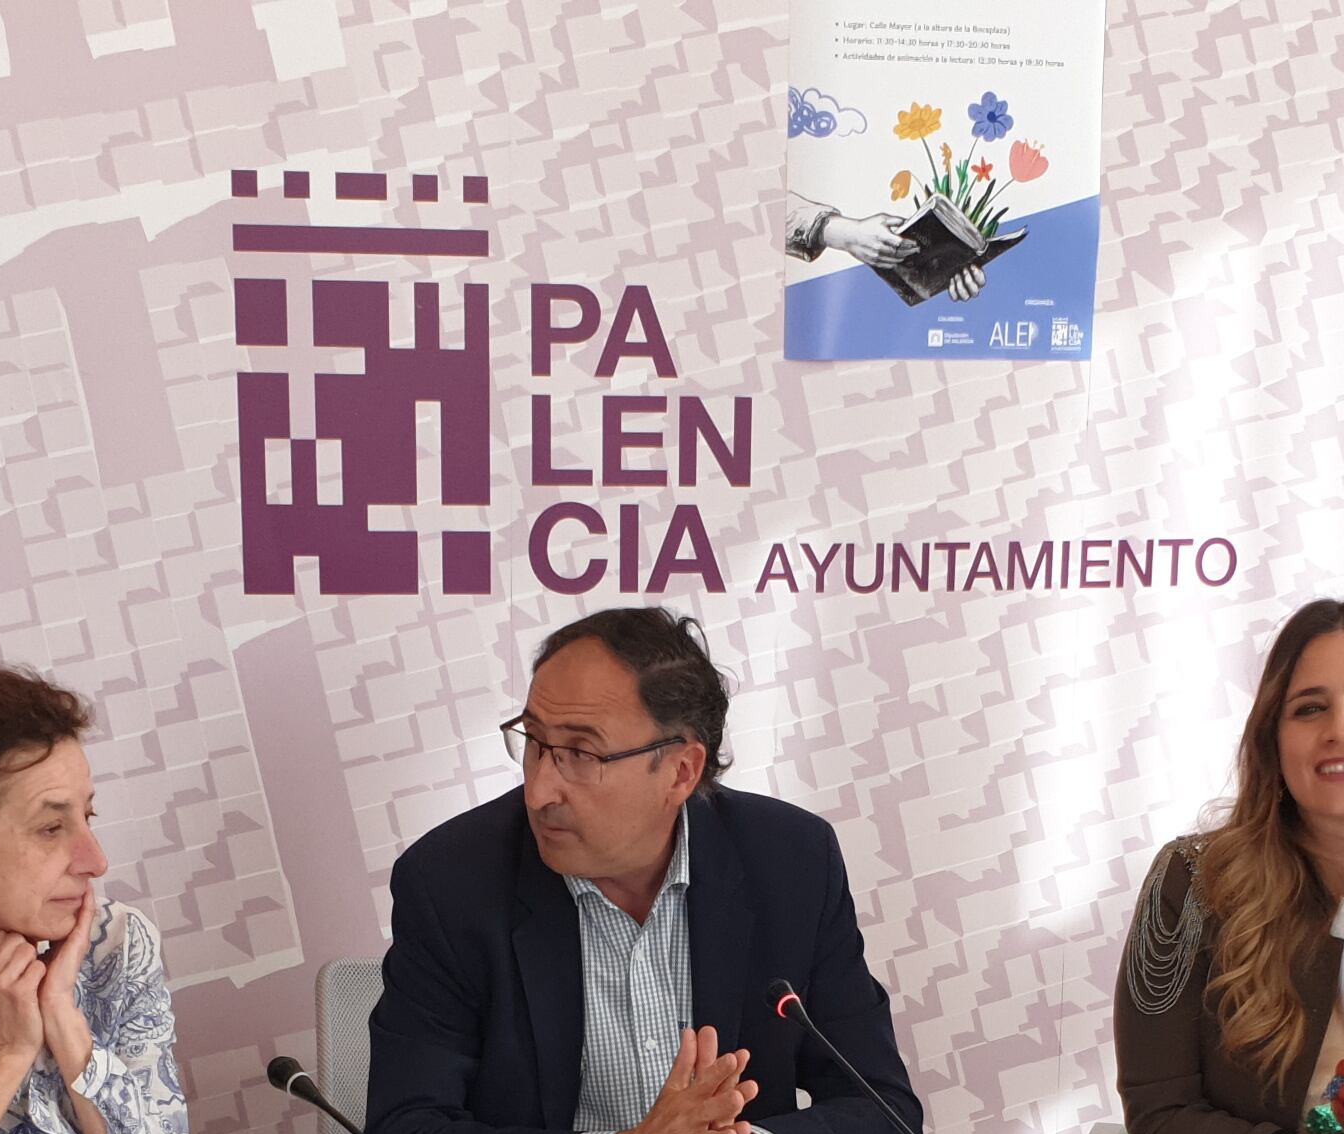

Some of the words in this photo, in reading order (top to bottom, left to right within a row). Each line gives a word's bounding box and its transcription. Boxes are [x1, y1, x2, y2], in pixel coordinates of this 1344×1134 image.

[531, 284, 678, 378] PA
[531, 395, 752, 488] LEN
[528, 502, 727, 595] CIA
[755, 537, 1238, 594] AYUNTAMIENTO
